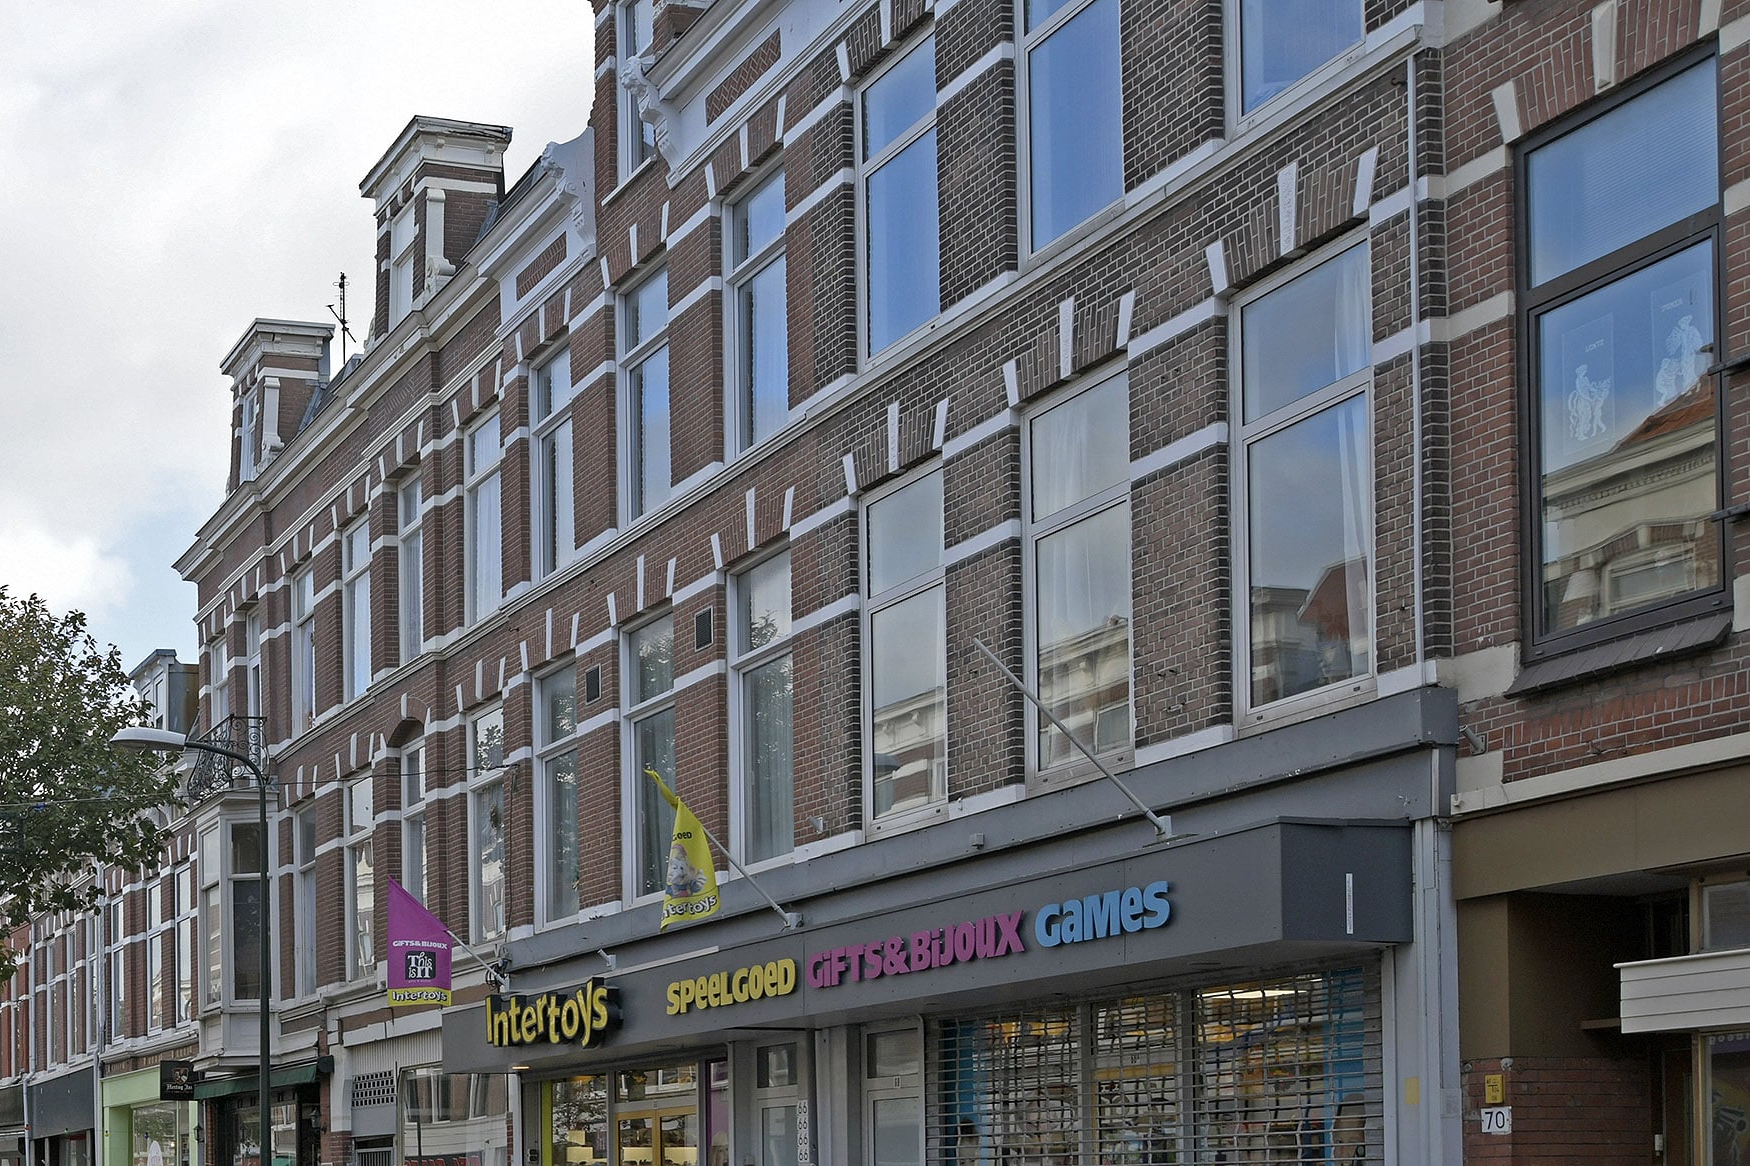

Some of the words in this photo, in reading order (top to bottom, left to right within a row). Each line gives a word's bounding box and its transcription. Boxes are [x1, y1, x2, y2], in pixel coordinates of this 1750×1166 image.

[662, 894, 718, 919] ntertoys
[407, 951, 433, 968] This
[392, 991, 448, 1001] Intertoys
[485, 980, 610, 1048] Intertoys
[1485, 1111, 1505, 1130] 70
